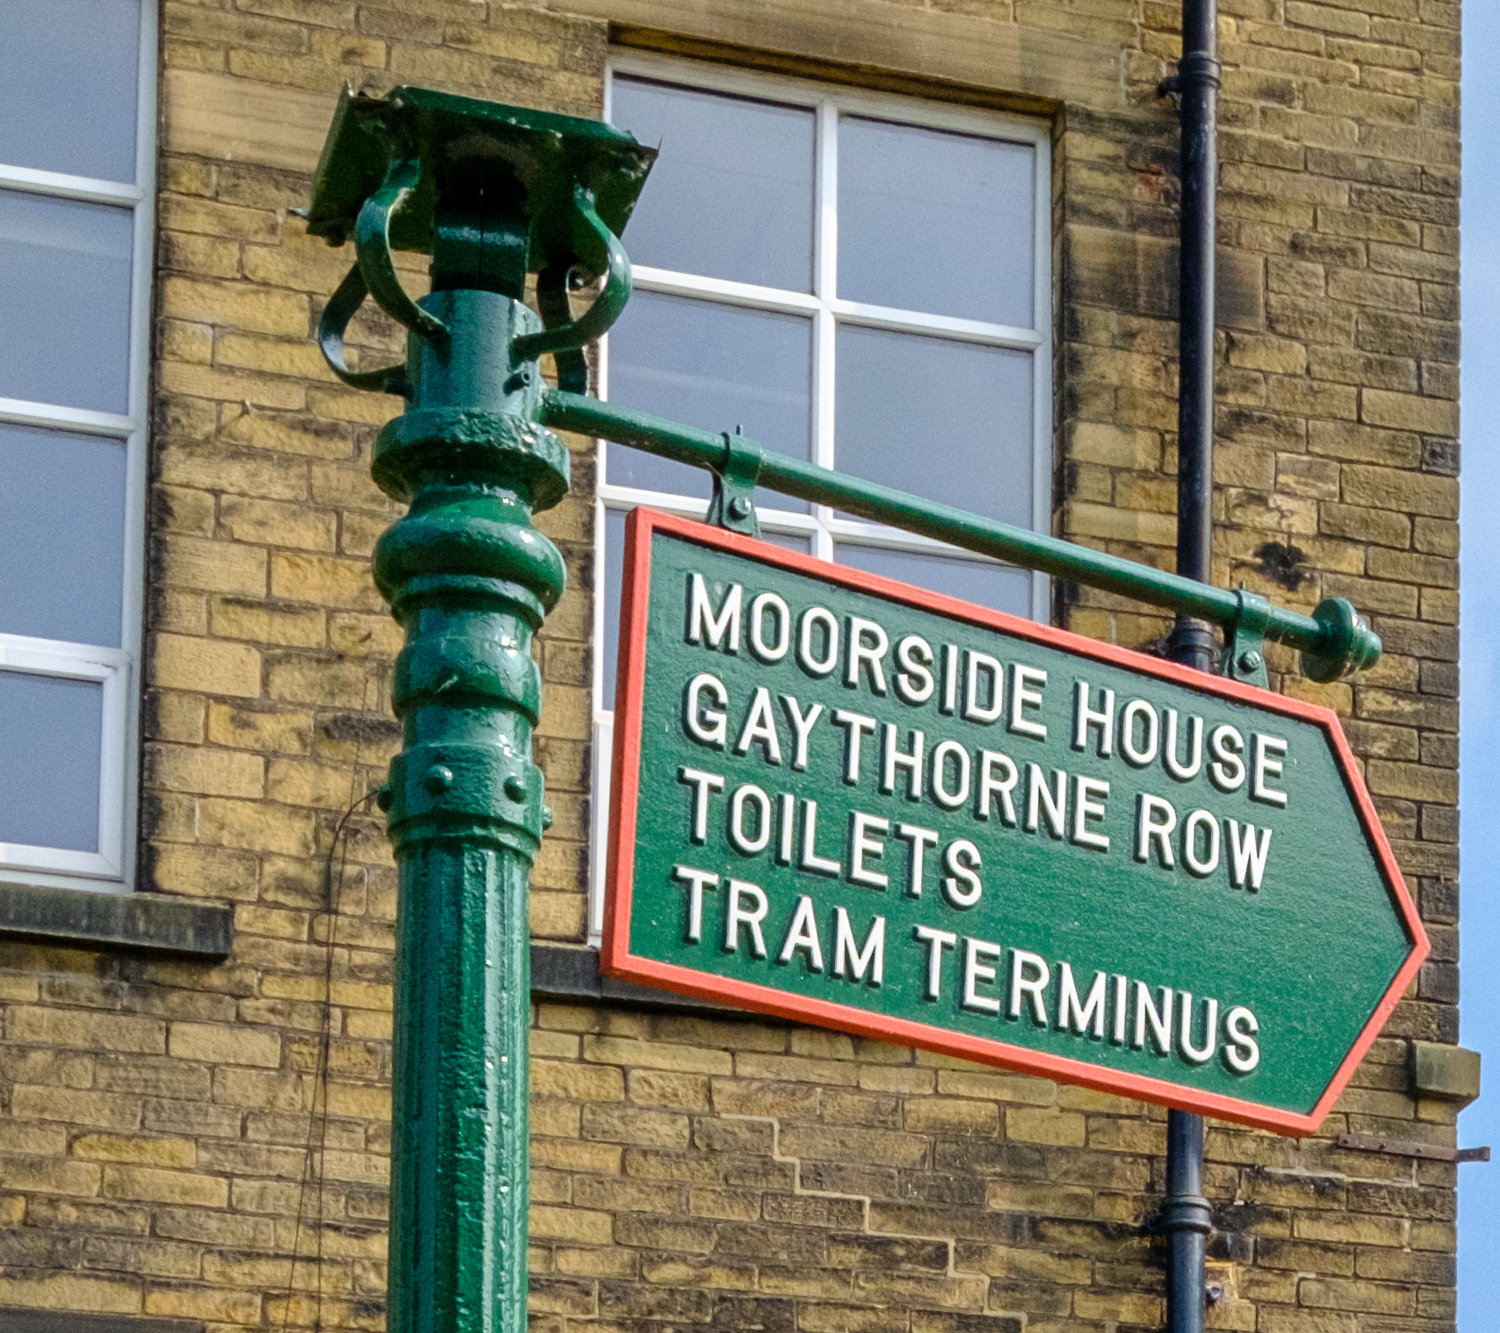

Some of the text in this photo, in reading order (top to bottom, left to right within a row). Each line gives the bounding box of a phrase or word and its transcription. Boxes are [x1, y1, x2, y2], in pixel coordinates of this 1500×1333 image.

[686, 673, 1274, 890] GAYTHORNE ROW
[689, 572, 1289, 805] MOORSIDE HOUSE
[683, 767, 984, 907] TOILETS
[676, 865, 1261, 1073] TRAM TERMINUS
